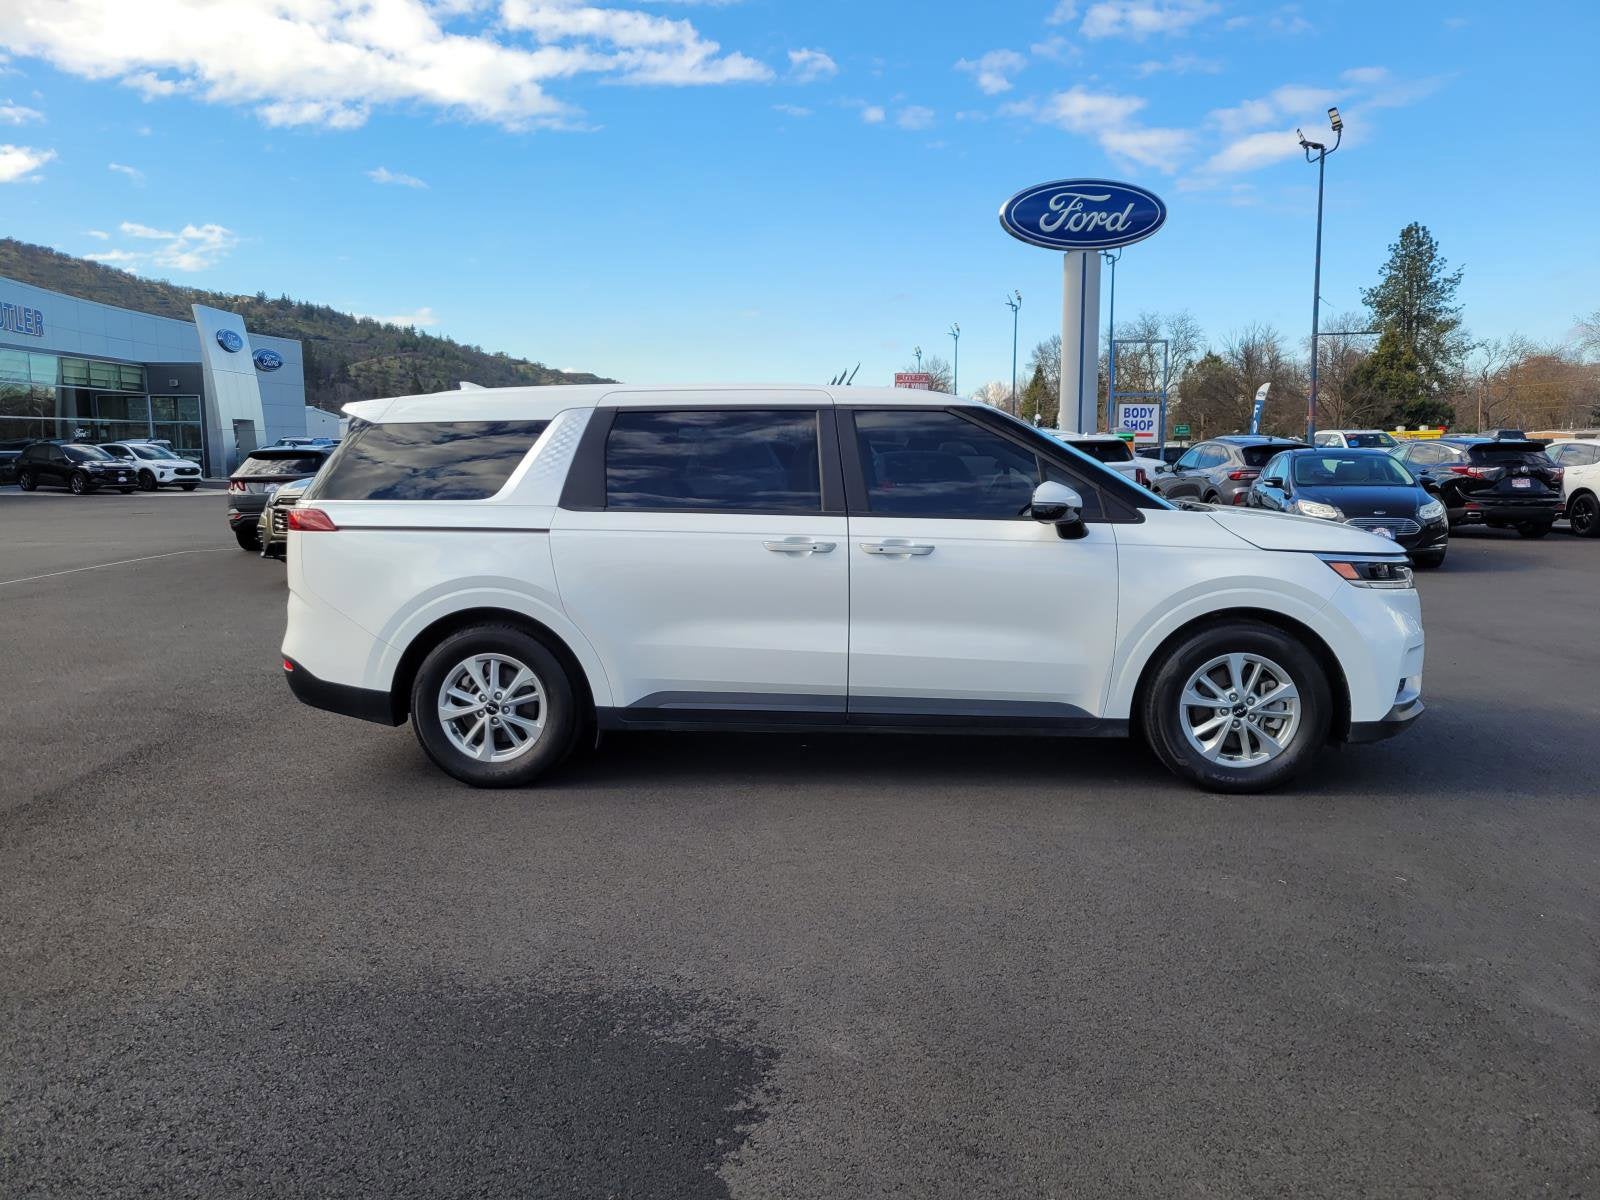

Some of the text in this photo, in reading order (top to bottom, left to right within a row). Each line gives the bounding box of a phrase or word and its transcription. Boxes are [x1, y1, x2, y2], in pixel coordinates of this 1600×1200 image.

[1039, 192, 1135, 232] Ford
[1123, 407, 1154, 418] BODY
[1123, 420, 1154, 431] SHOP
